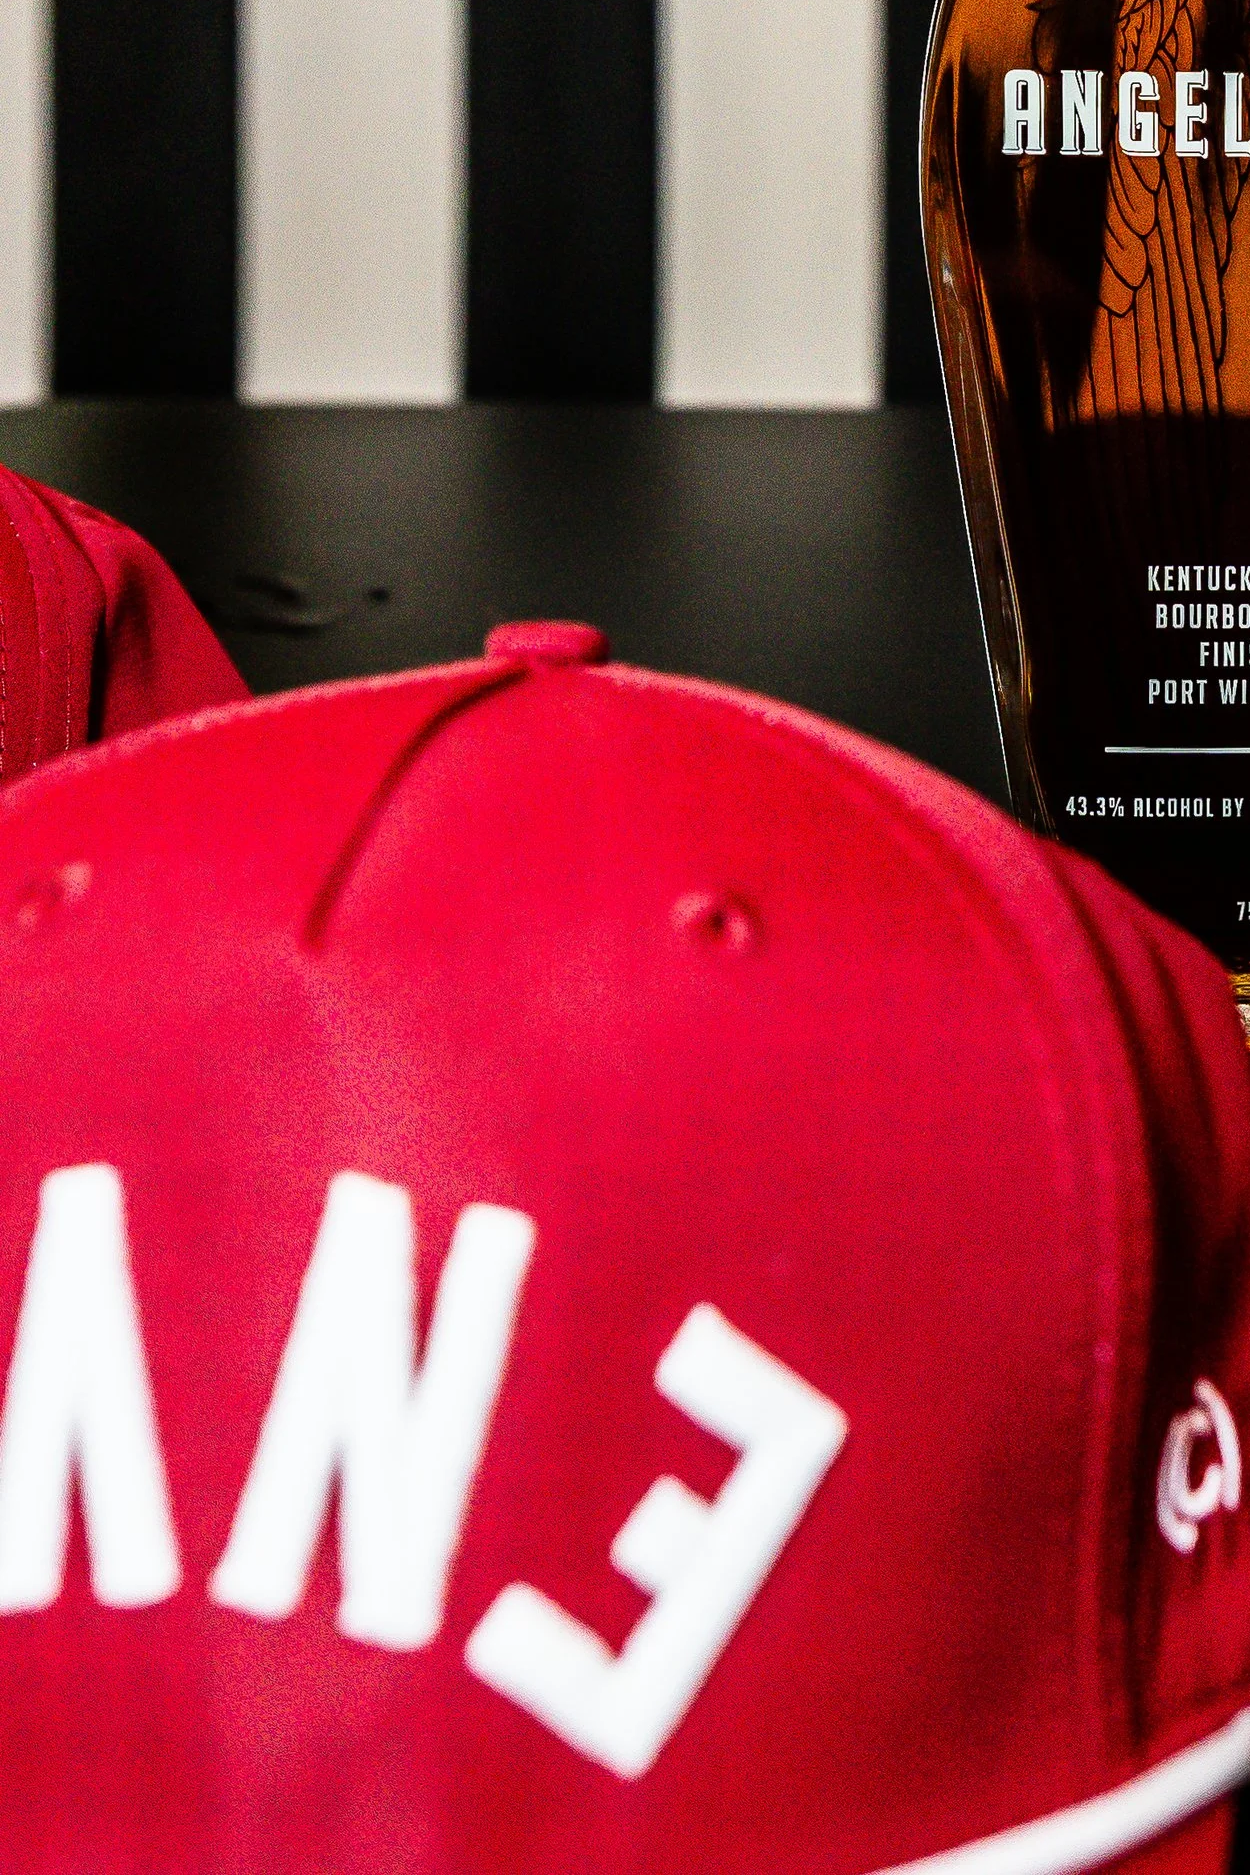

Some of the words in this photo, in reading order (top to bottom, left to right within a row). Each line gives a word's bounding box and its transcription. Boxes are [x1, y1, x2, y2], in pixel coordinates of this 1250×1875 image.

[1148, 678, 1208, 705] PORT
[1065, 796, 1125, 818] 43.3%
[1133, 797, 1214, 818] ALCOHOL
[1222, 797, 1244, 818] BY
